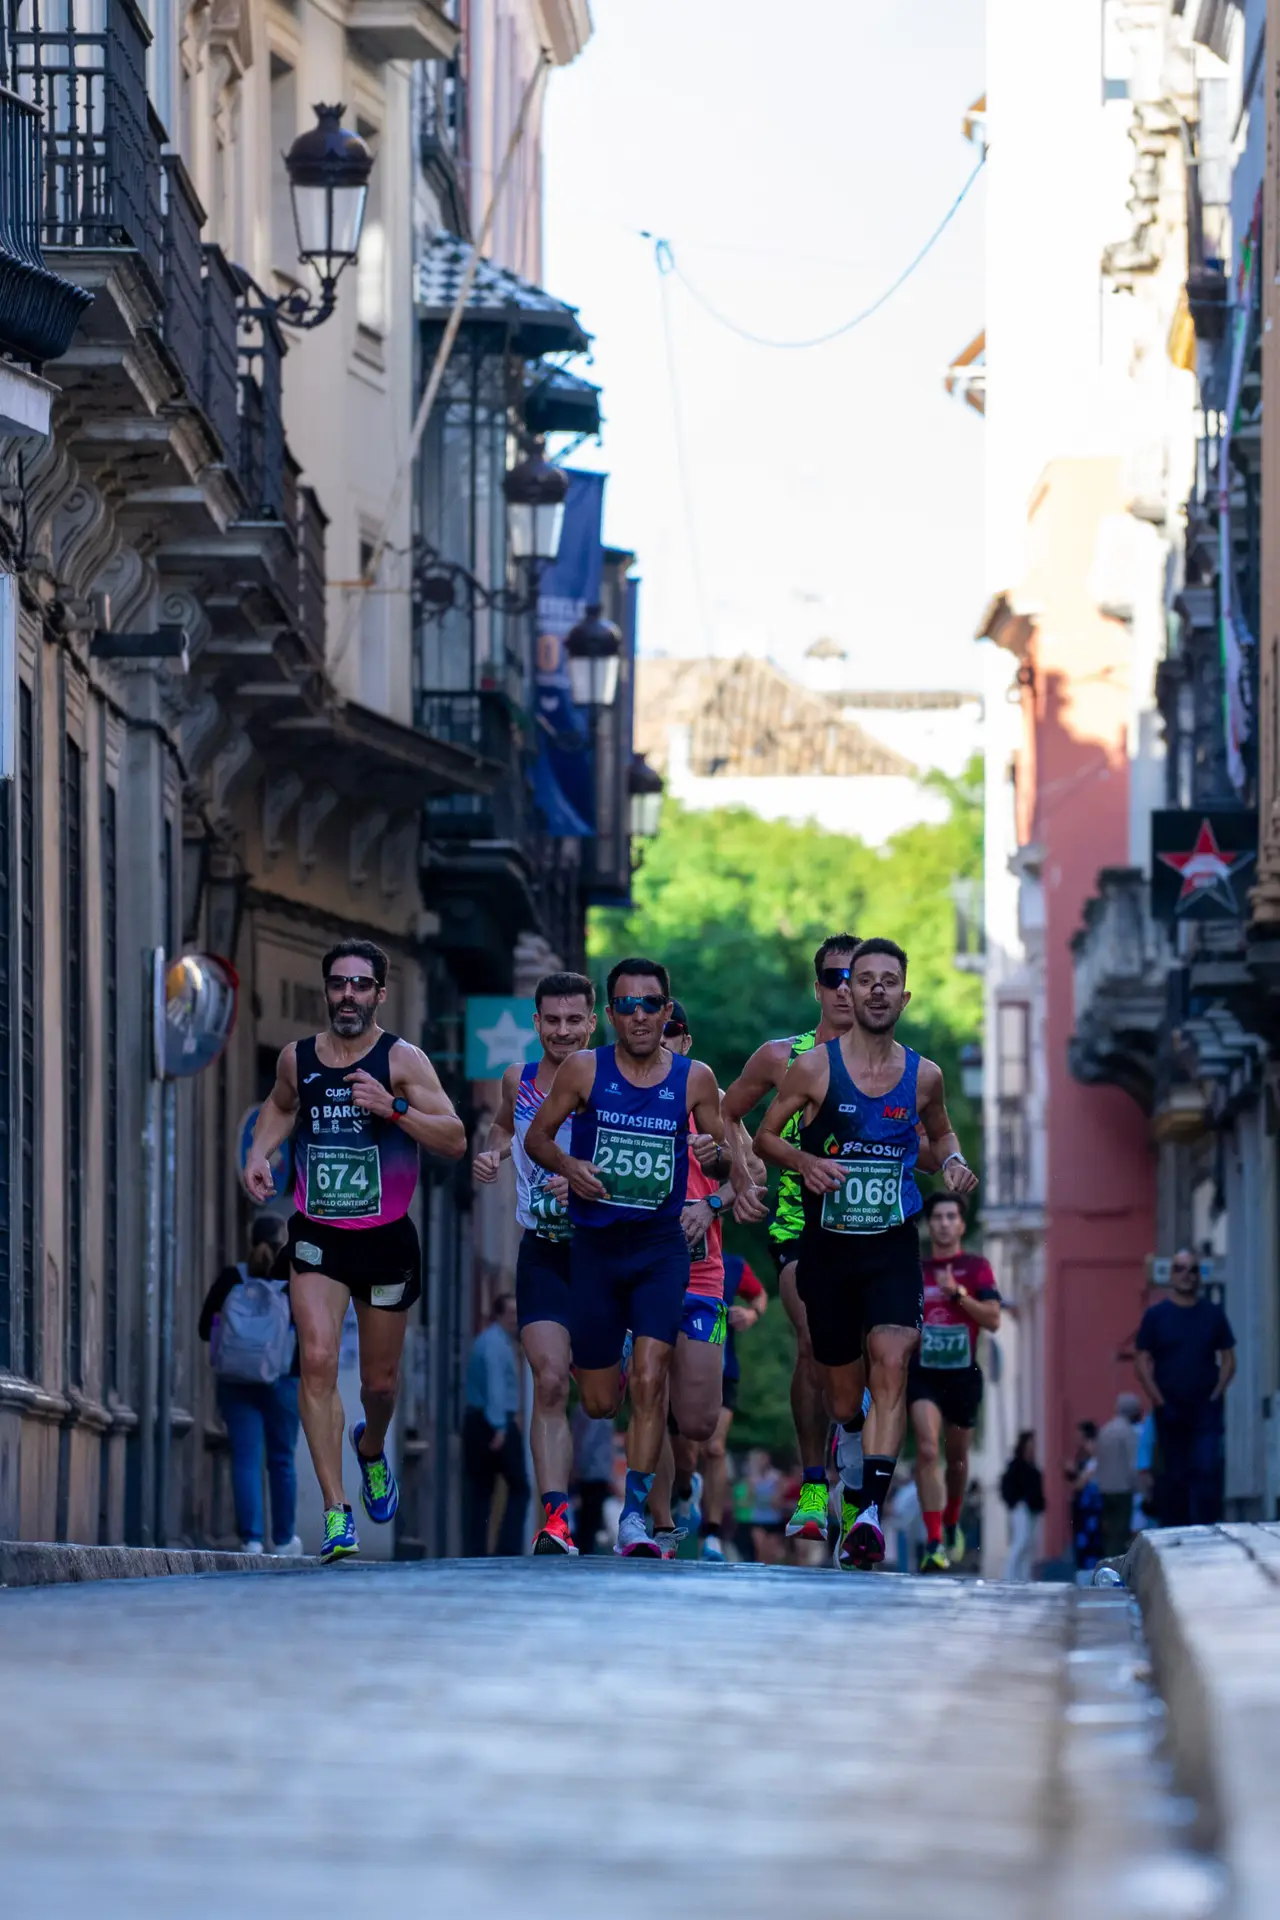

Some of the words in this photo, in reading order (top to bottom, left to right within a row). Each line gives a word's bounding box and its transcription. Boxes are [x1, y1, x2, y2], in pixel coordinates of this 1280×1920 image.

[596, 1109, 678, 1132] TROTASIERRA
[841, 1141, 906, 1158] gacosur
[597, 1146, 671, 1181] 2595
[316, 1163, 369, 1191] 674
[834, 1177, 897, 1206] 1068
[336, 1199, 369, 1207] CANTERO
[842, 1214, 864, 1223] TORO
[924, 1333, 966, 1351] 2577
